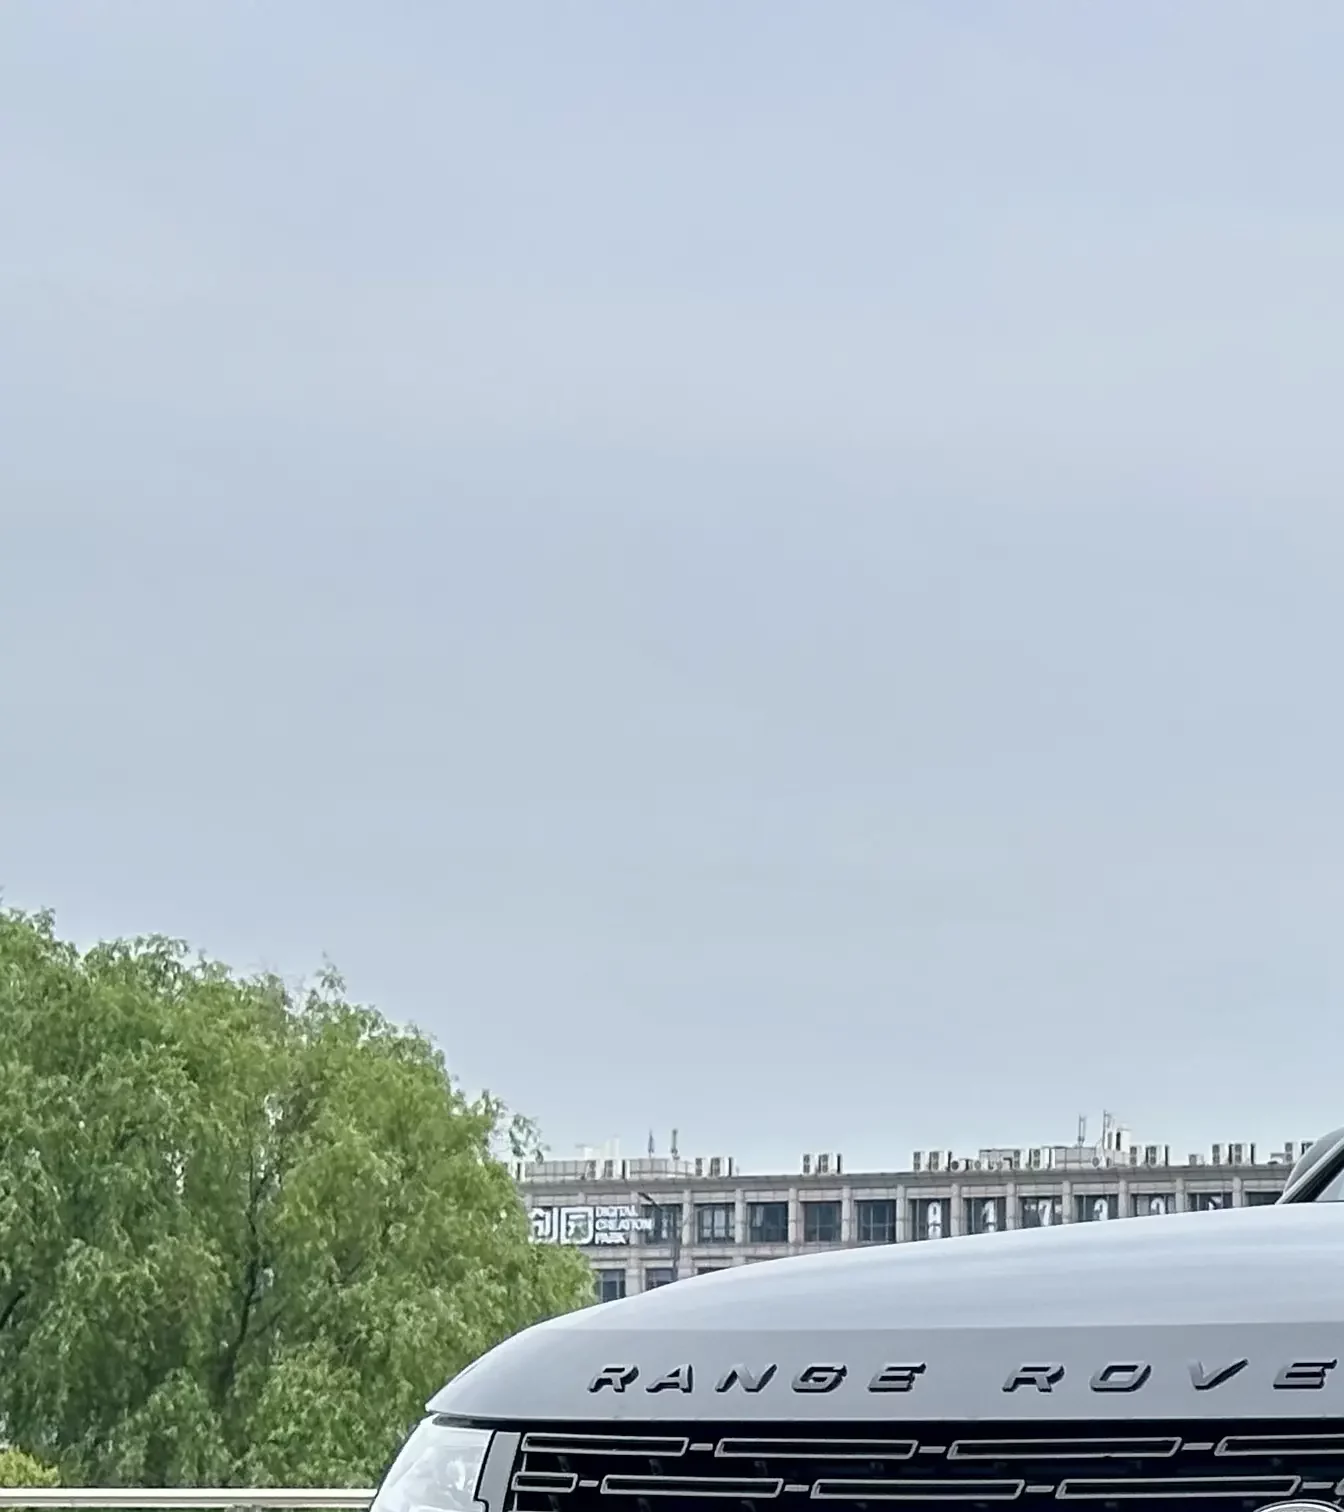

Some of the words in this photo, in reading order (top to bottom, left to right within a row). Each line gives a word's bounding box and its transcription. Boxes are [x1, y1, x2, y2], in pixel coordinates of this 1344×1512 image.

[596, 1204, 639, 1217] DIGITAL
[595, 1217, 656, 1231] CREATION
[595, 1231, 627, 1245] PARK
[587, 1362, 927, 1394] RANGE
